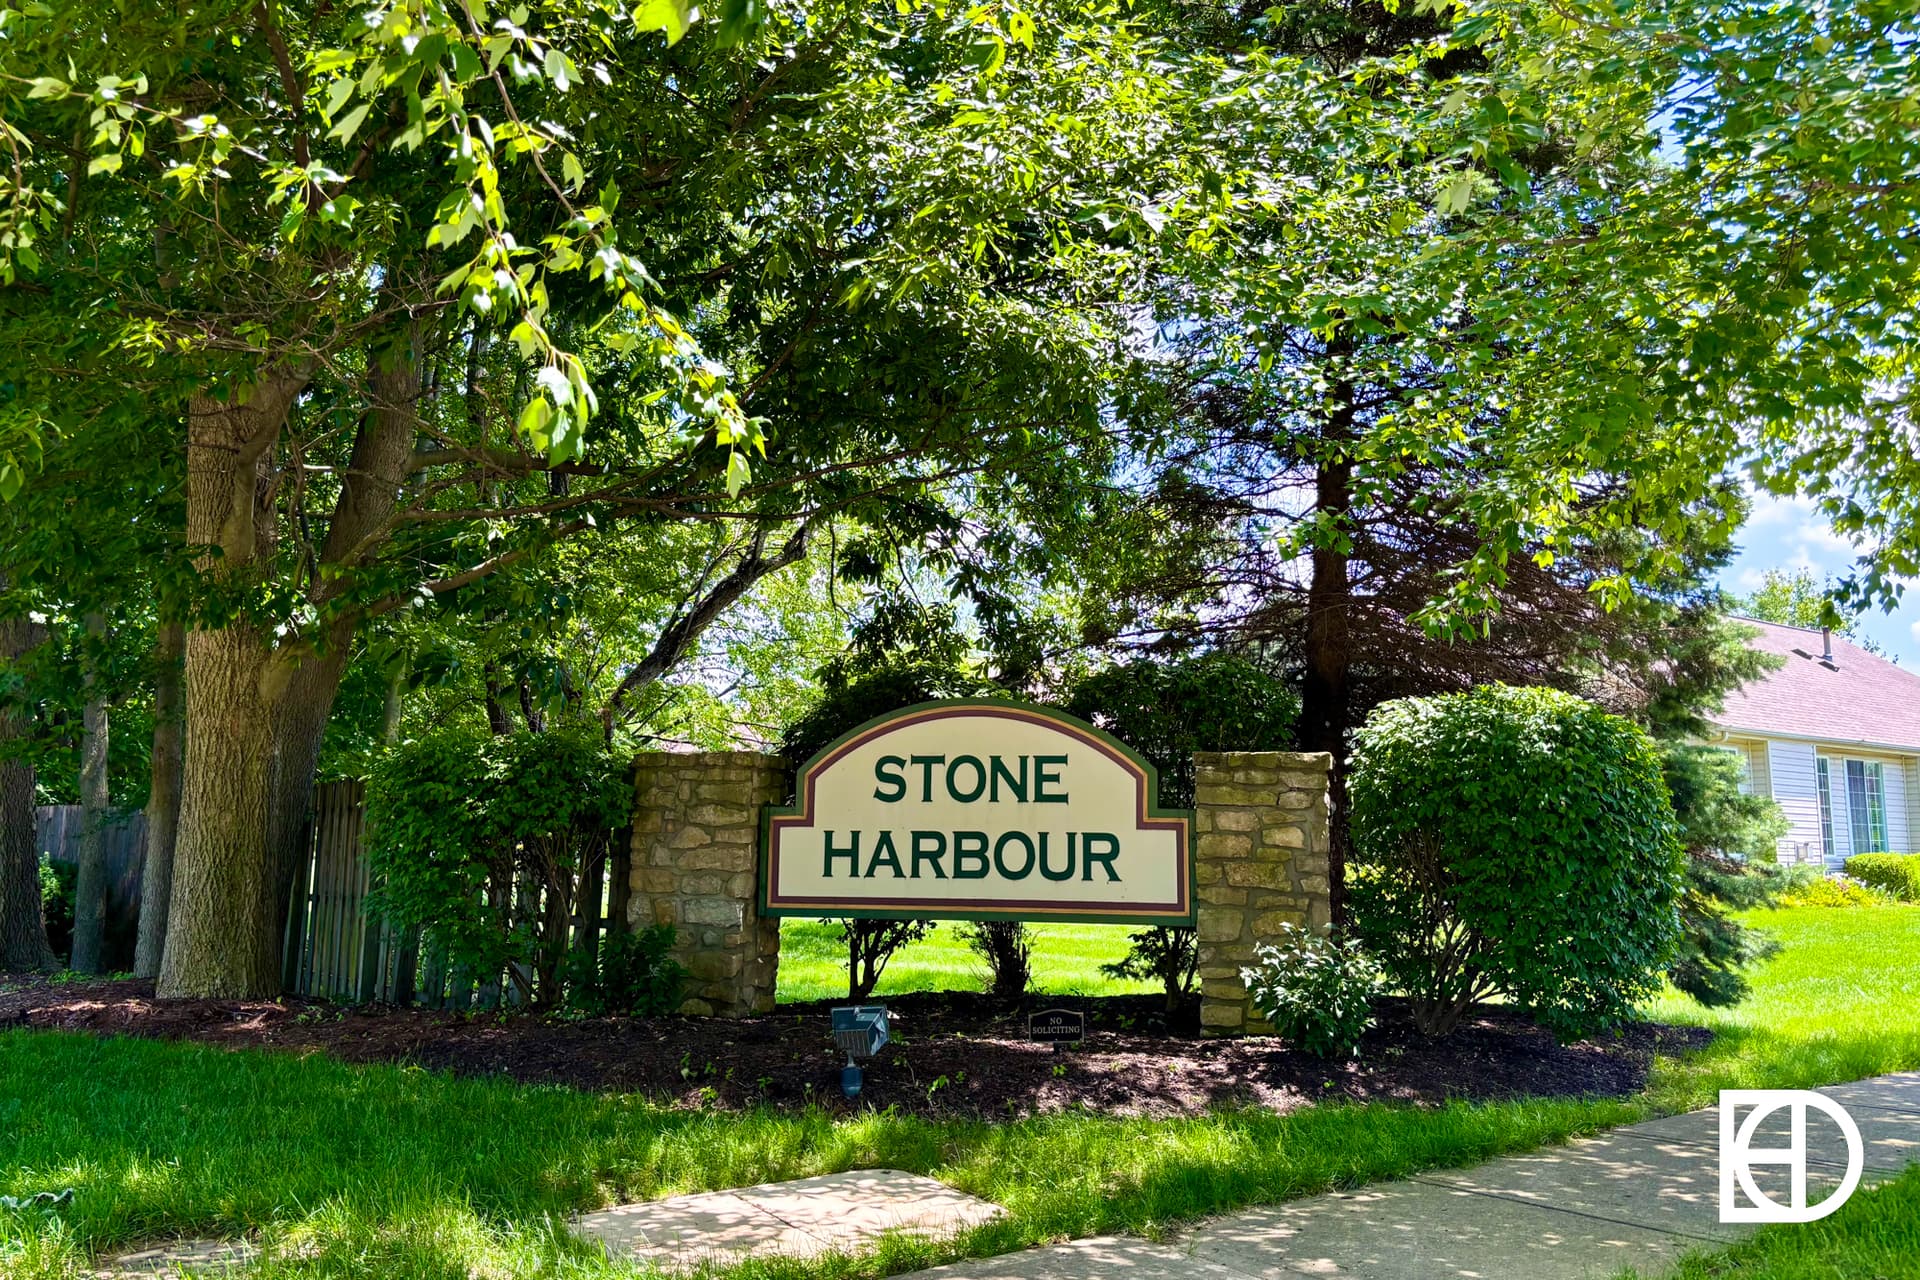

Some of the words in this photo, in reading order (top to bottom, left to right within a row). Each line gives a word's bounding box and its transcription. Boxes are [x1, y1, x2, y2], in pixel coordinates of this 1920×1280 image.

[873, 754, 1069, 804] STONE
[822, 830, 1122, 882] HARBOUR
[1032, 1025, 1080, 1034] SOLICITING
[1049, 1017, 1063, 1025] NO
